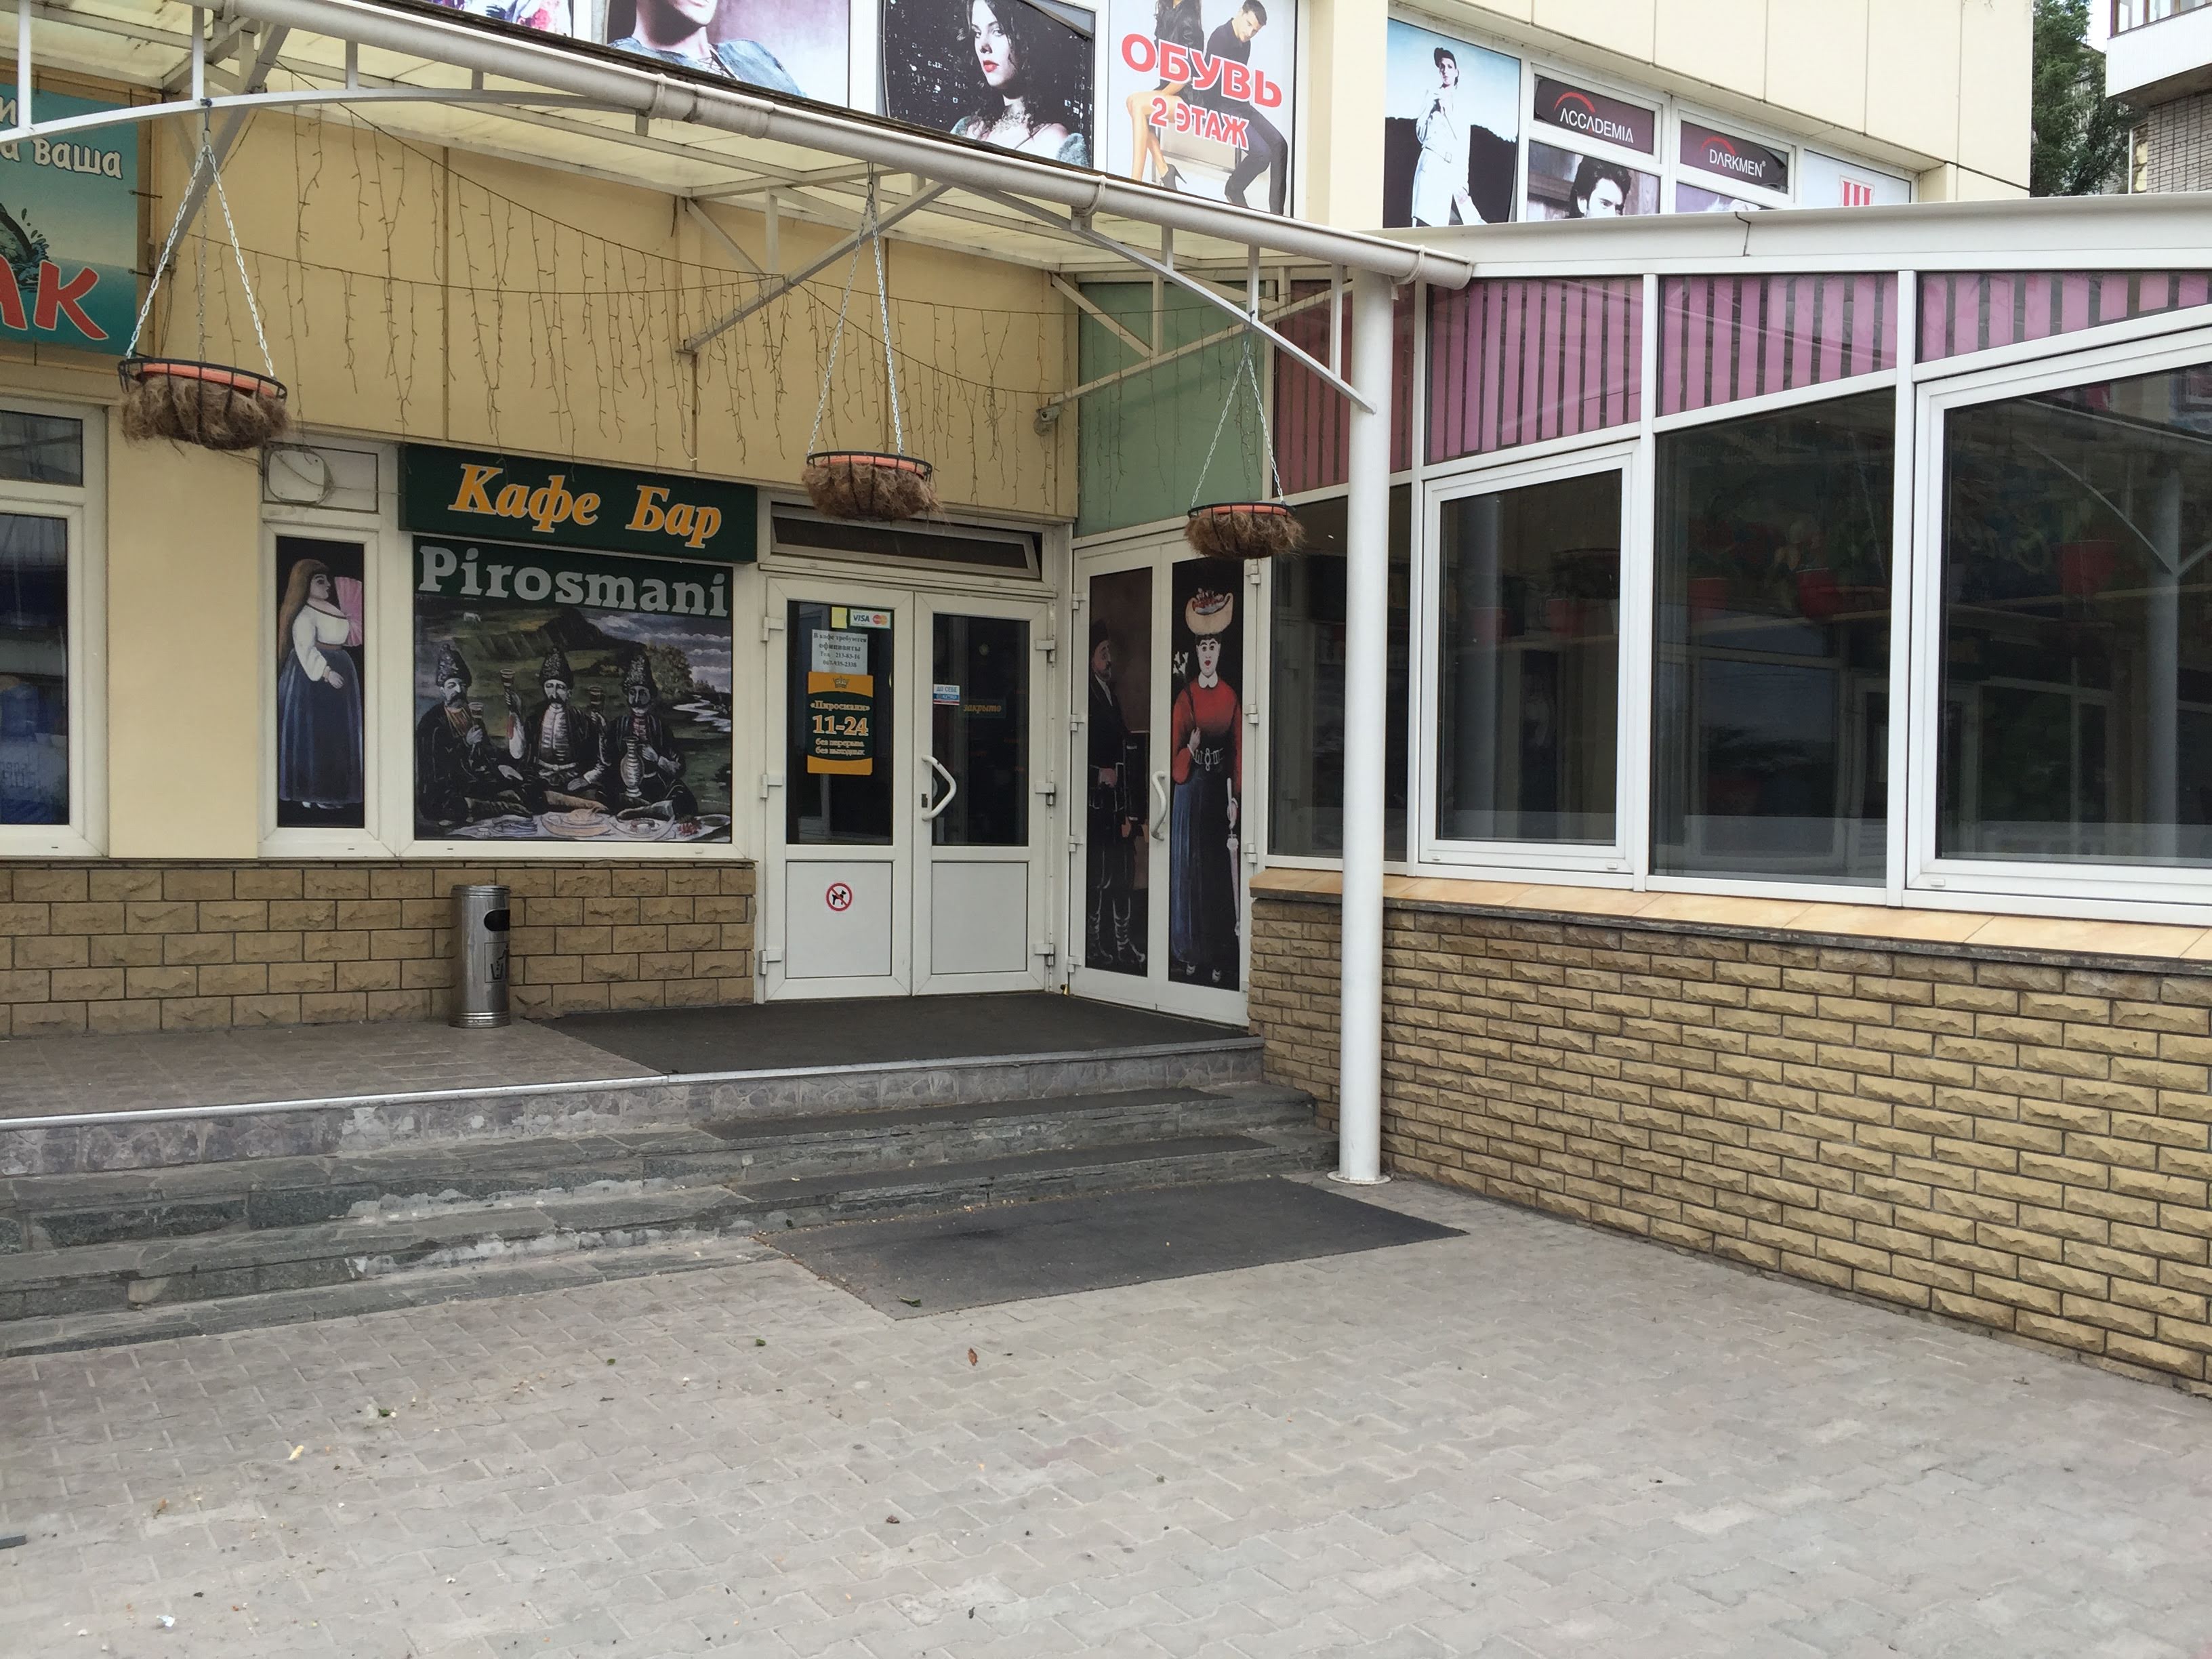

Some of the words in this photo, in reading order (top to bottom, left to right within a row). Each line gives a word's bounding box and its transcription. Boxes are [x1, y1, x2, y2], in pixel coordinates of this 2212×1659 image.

[1120, 32, 1283, 108] ОБУВЬ
[1150, 96, 1168, 127] 2
[1174, 102, 1249, 150] ЭТАЖ
[1559, 107, 1634, 144] ACCADEMIA
[33, 138, 123, 180] ваша
[1709, 148, 1762, 178] DARKMEN
[447, 463, 601, 533] Кафе
[625, 485, 722, 549] Бар
[417, 546, 729, 617] Pirosmani
[812, 714, 869, 737] 11-24
